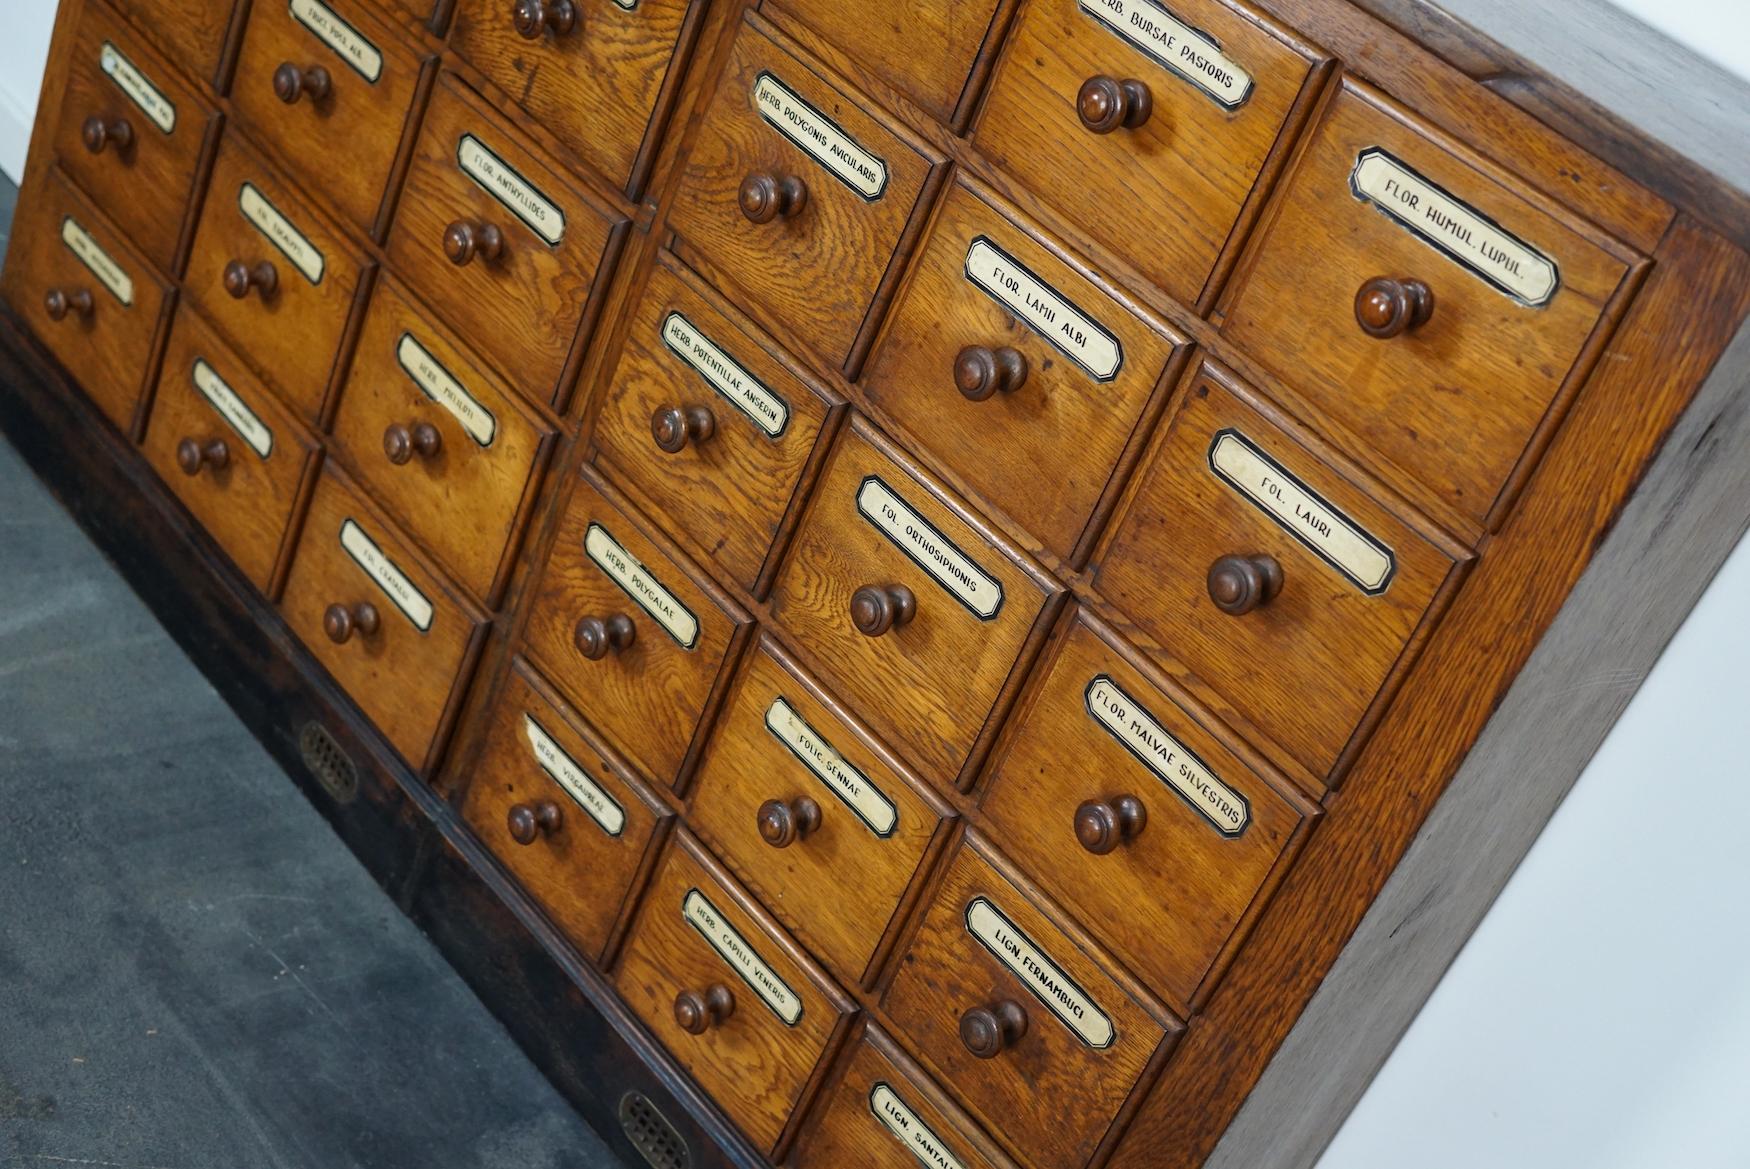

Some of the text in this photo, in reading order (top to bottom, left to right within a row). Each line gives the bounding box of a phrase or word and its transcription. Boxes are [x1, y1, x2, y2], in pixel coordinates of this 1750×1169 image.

[1130, 11, 1177, 50] BURSAE
[1180, 45, 1234, 88] PASTORIS
[784, 107, 828, 147] POLYGONIS
[830, 144, 877, 184] AVICULARIS
[496, 174, 547, 221] ANTHYLLIDES
[1385, 179, 1525, 280] FLOR. HUMUL. LUPUL.
[993, 267, 1087, 348] FLOR. LAMII ALBI
[693, 344, 742, 391] POTENTILLAE
[743, 389, 778, 423] ANSERIN.
[1261, 477, 1331, 539] FOL. LAURI
[882, 504, 977, 592] FOL. ORTHOSIPHONIS
[631, 575, 676, 620] POLYGALAE
[799, 734, 861, 798] FOLIC. SENNAE
[1096, 689, 1240, 824] FLOR. MALVAE SILVESTRIS
[722, 934, 751, 967] CAPILLI
[754, 966, 786, 1004] VENERIS
[995, 929, 1085, 1020] LIGN. FERNAMBUCI
[884, 1101, 909, 1131] LIGN.
